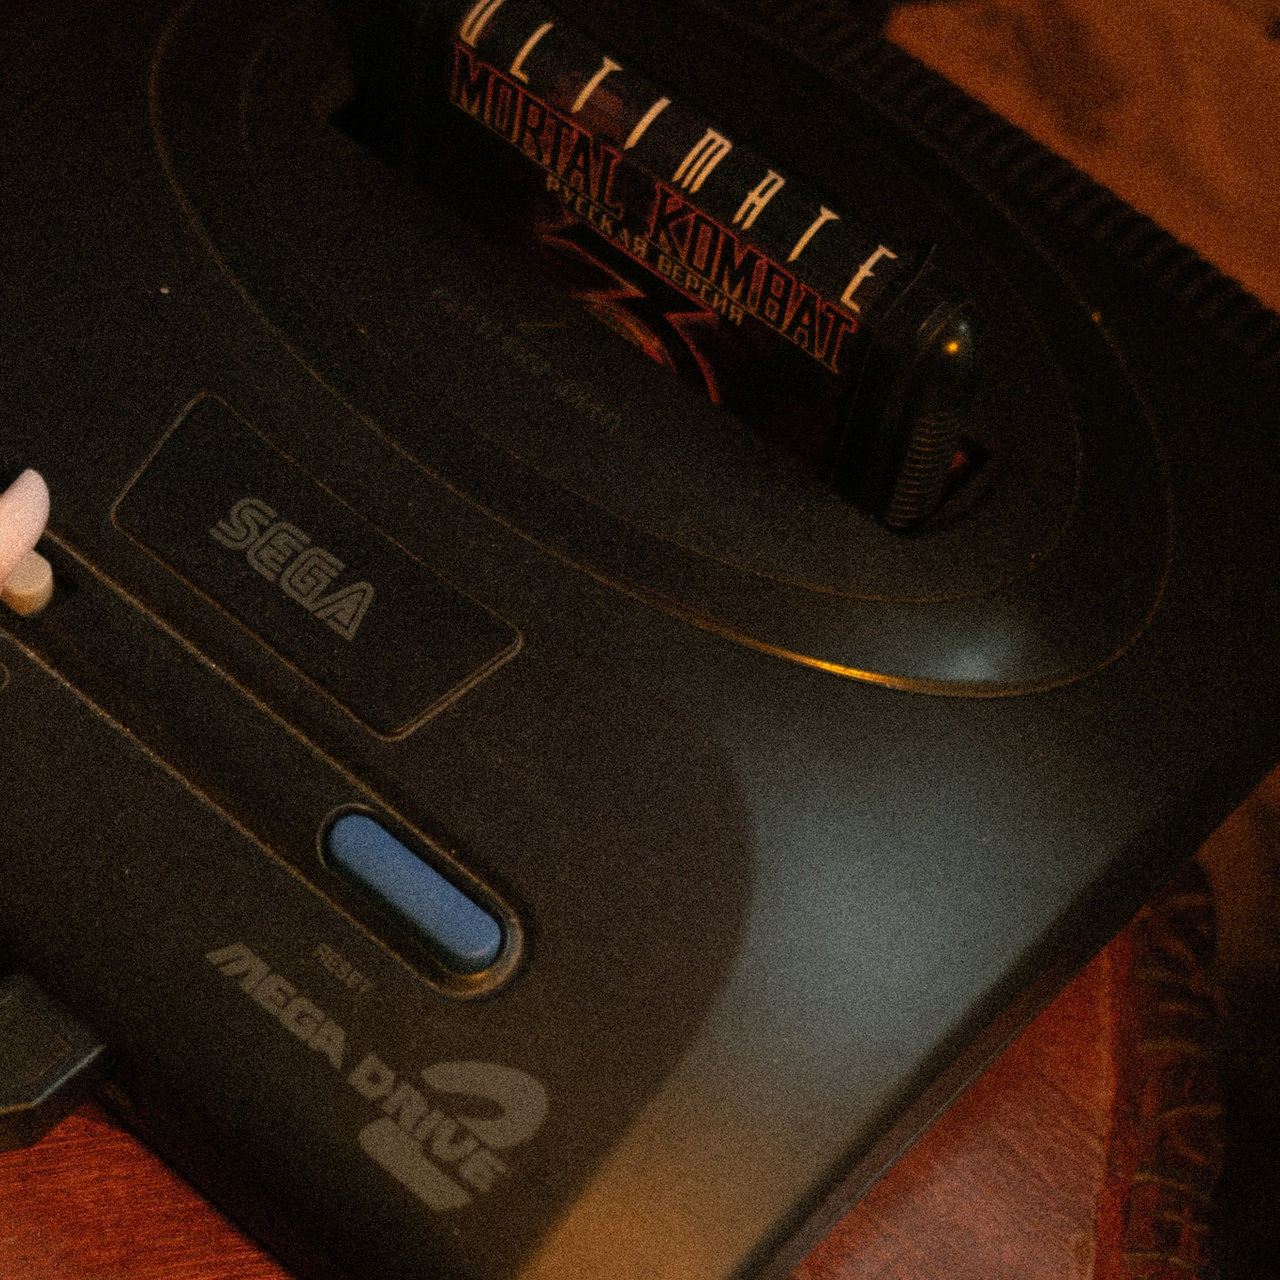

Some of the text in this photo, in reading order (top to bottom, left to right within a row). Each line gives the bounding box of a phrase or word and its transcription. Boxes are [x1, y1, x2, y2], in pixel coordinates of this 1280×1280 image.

[449, 41, 624, 216] MORTAL
[646, 180, 860, 375] KOMBAT
[546, 179, 745, 327] РУССКАЯ ВЕРСИЯ
[209, 495, 376, 642] SEGA
[313, 942, 377, 995] RESET
[204, 941, 349, 1071] MEGA
[347, 1053, 509, 1194] DRIVE
